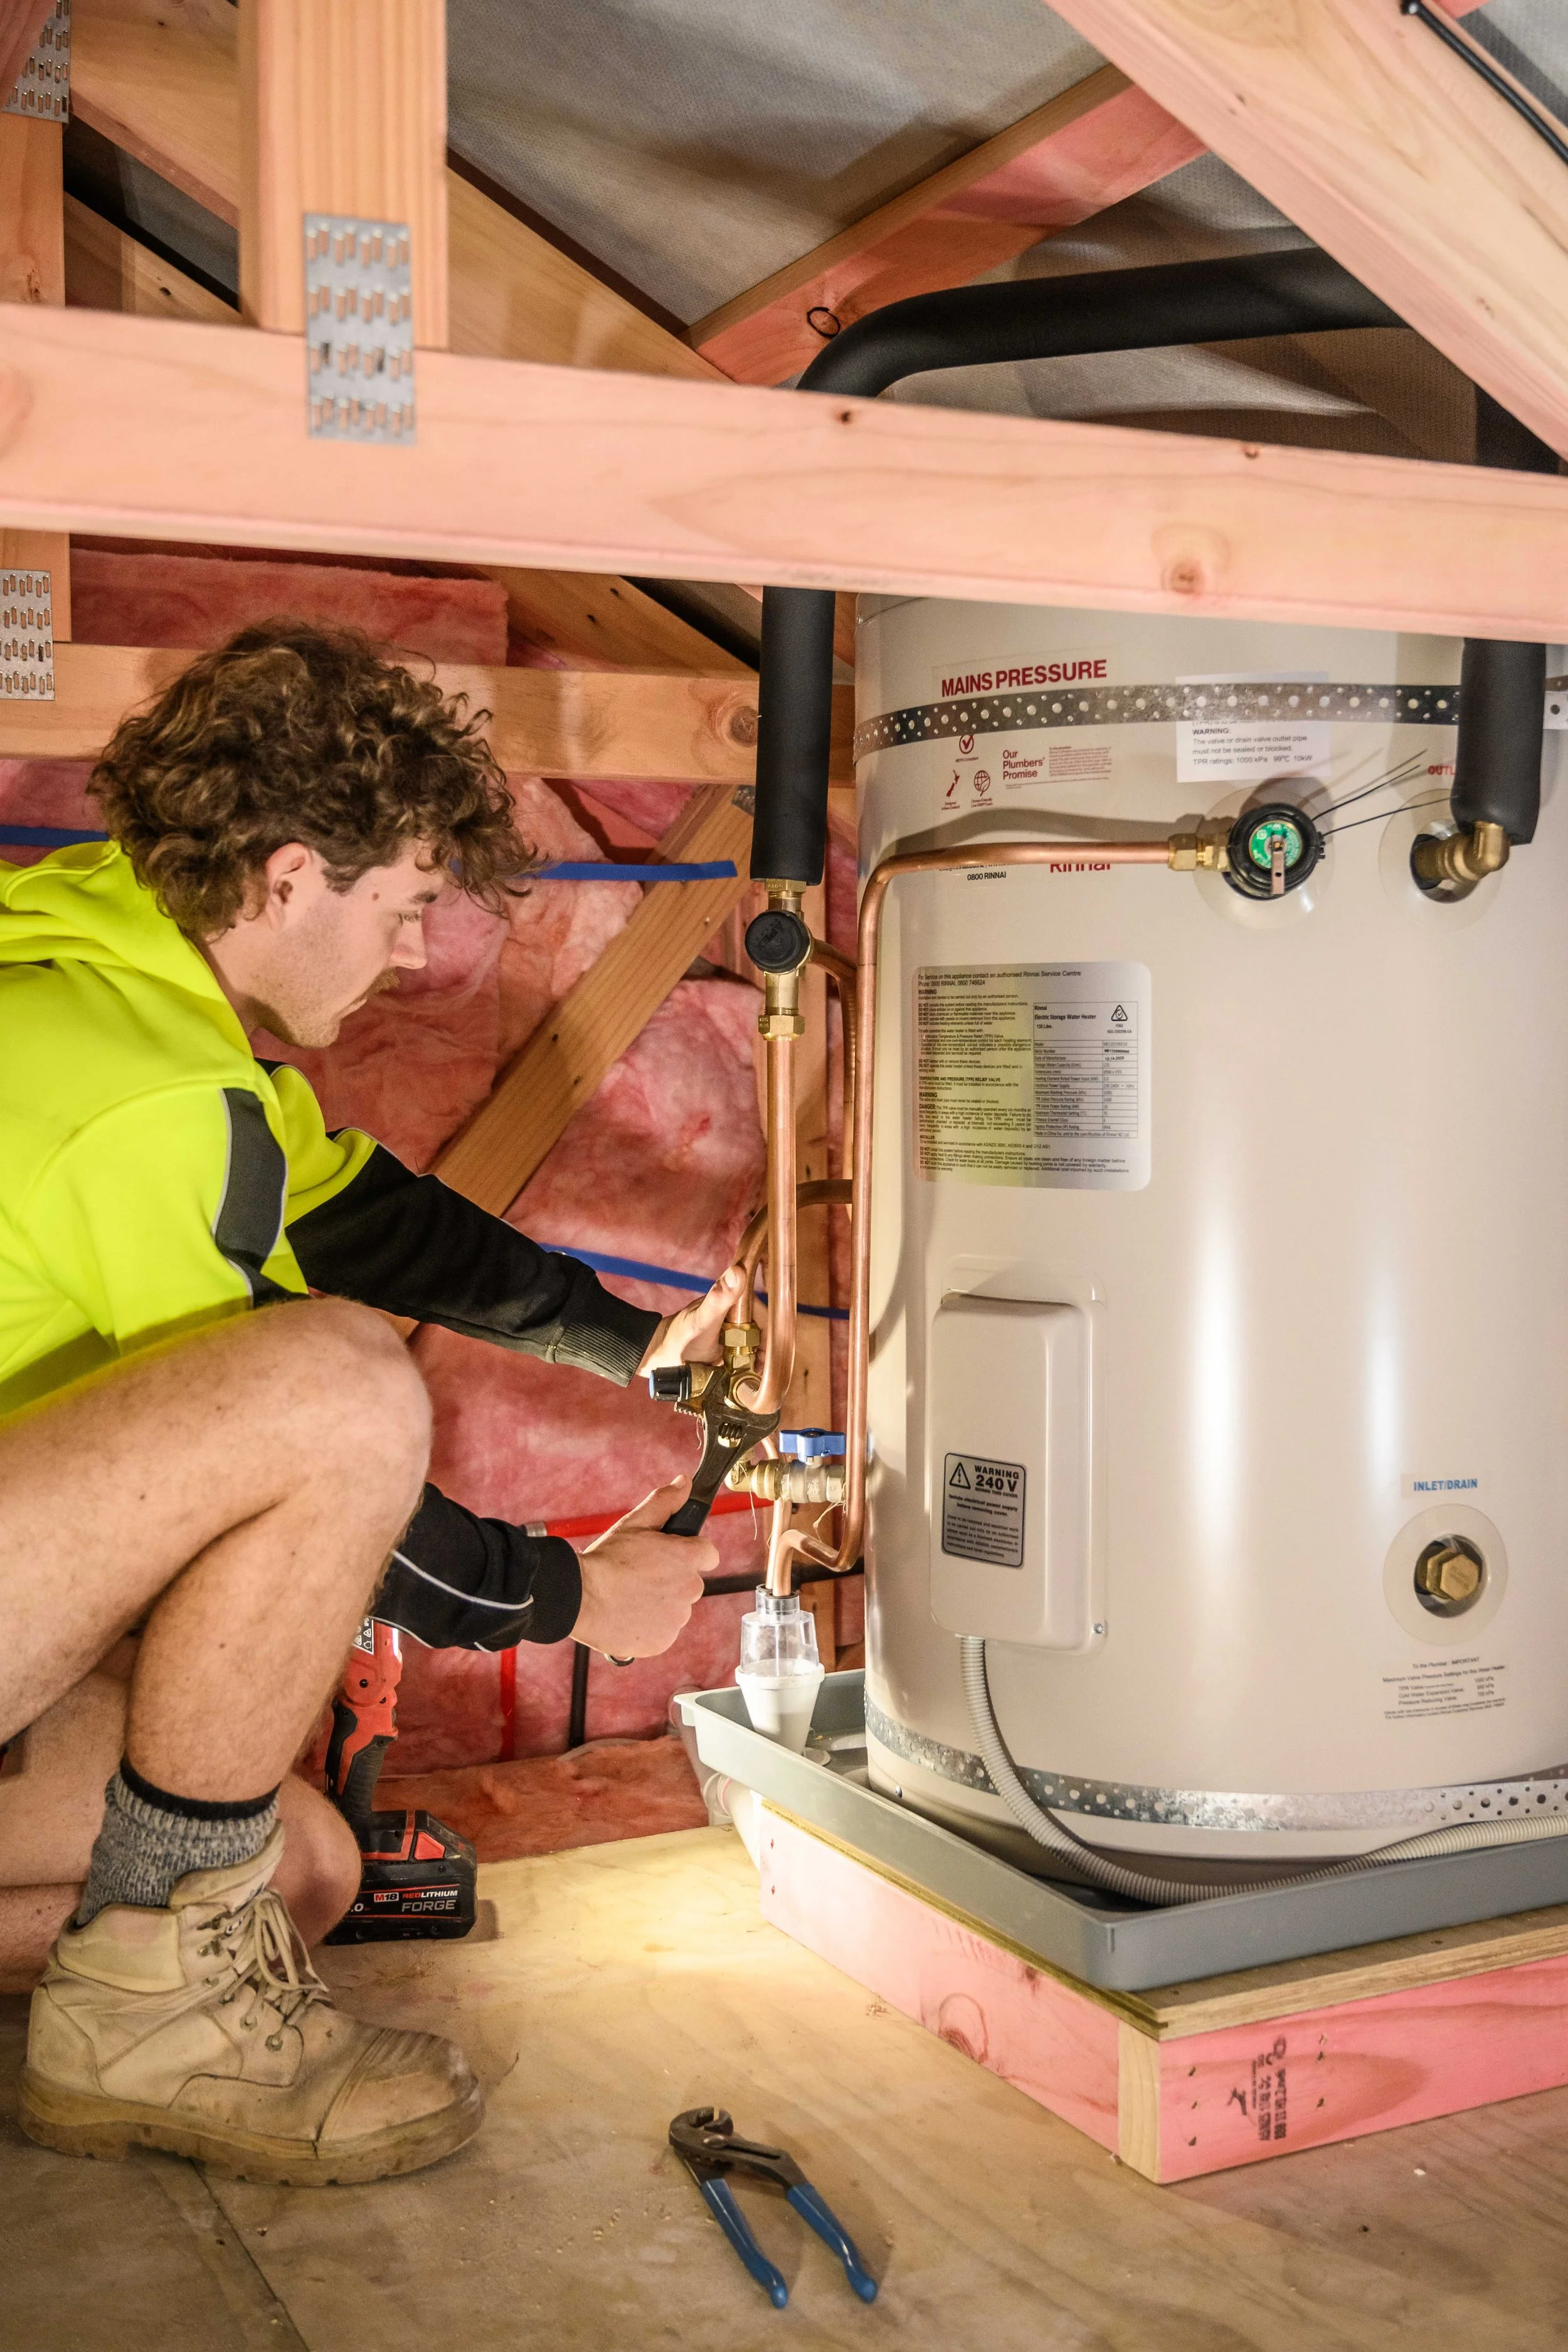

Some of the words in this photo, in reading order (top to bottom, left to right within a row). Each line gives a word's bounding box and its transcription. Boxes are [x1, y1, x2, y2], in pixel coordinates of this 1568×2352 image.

[942, 672, 993, 697] MAINS
[995, 660, 1106, 689] PRESSURE
[1003, 750, 1018, 758] Our
[1004, 770, 1037, 780] Promise
[1428, 766, 1455, 775] OUTL
[975, 1465, 1019, 1479] WARNING
[976, 1475, 1004, 1490] 240
[1007, 1479, 1017, 1492] V
[1414, 1479, 1478, 1491] INLET/DRAIN
[375, 1893, 398, 1901] M18
[403, 1890, 458, 1899] REDLITHIUM
[401, 1900, 456, 1912] FORGE
